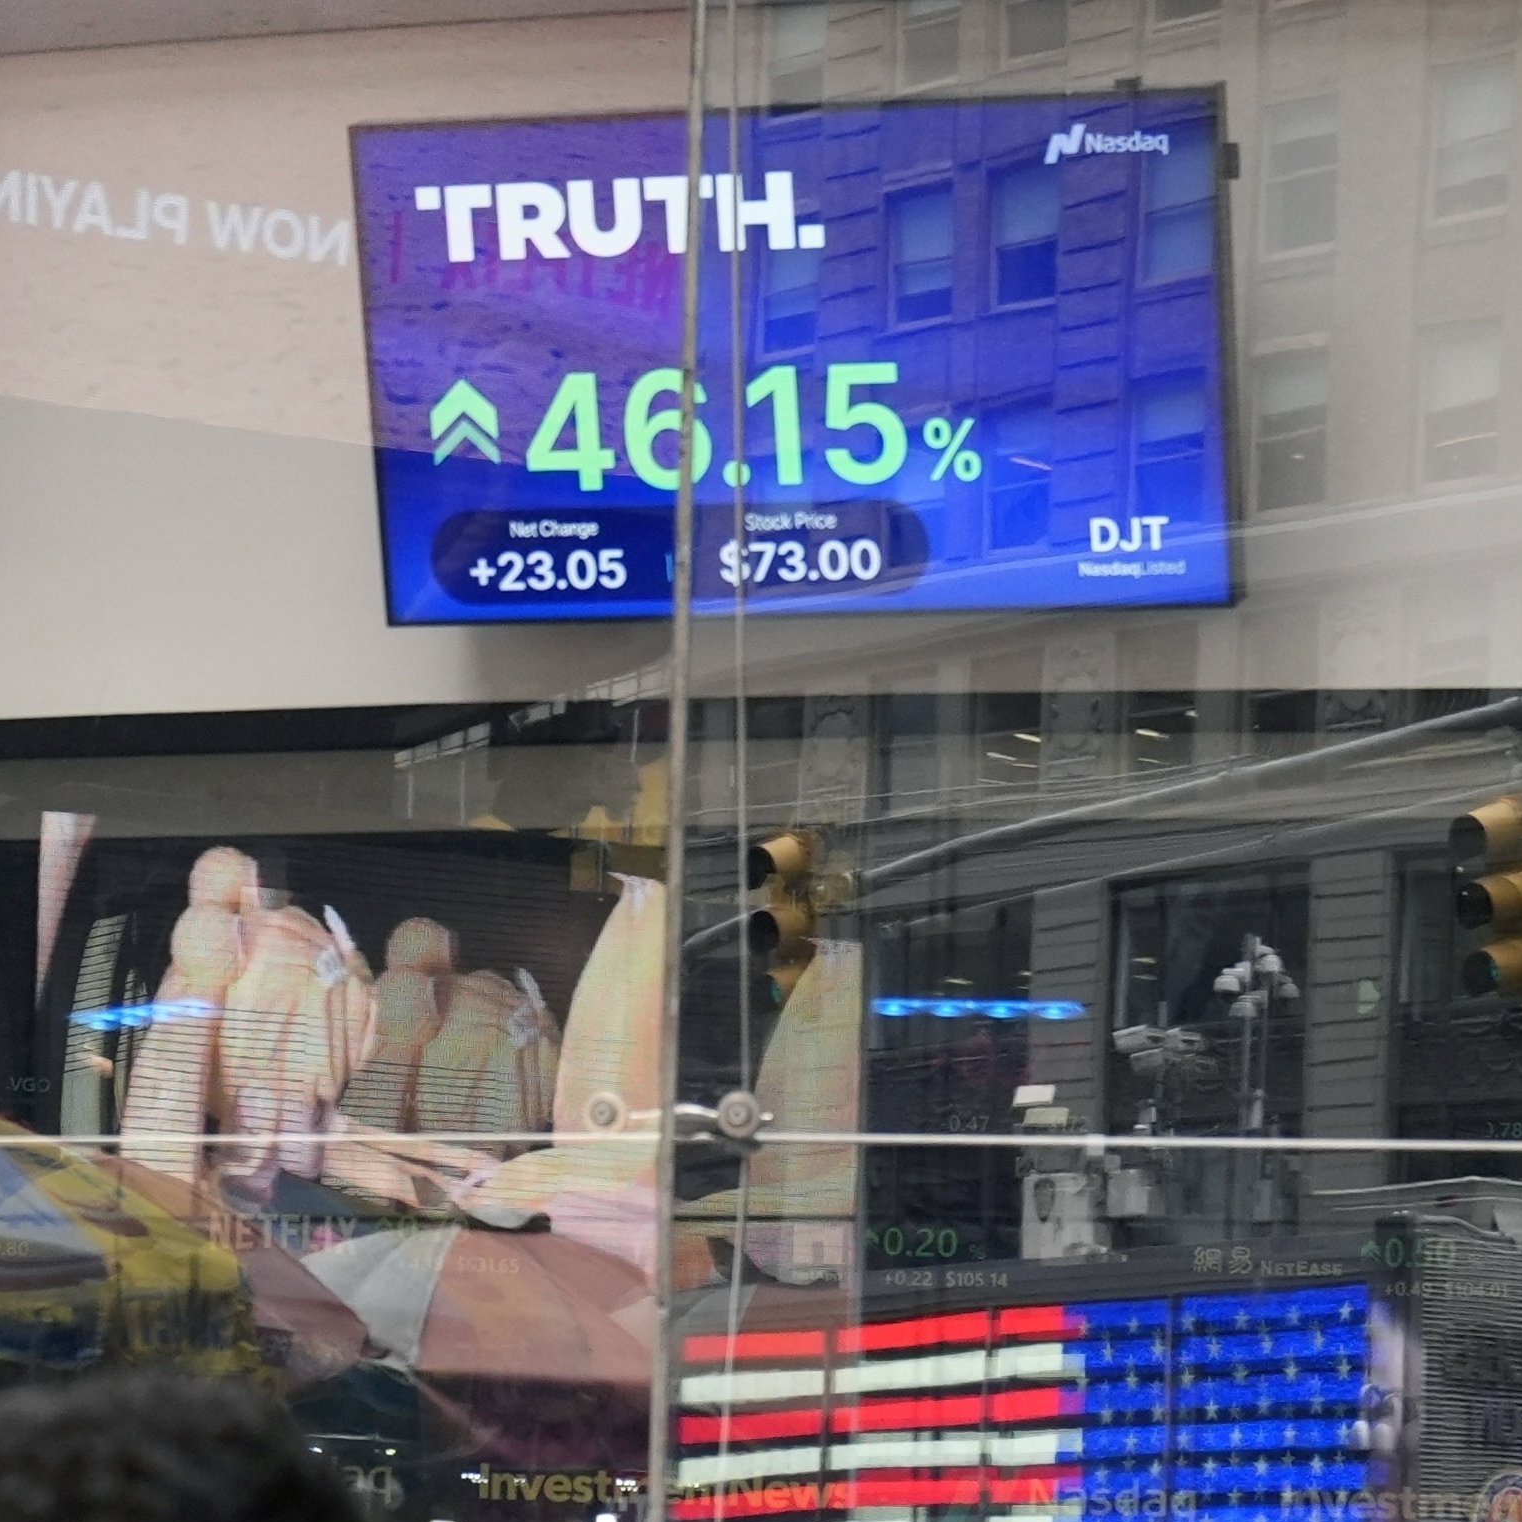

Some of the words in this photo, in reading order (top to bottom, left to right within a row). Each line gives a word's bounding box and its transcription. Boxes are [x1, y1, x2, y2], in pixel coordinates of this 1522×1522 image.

[1083, 128, 1170, 157] Nasdaq
[414, 169, 825, 263] TRUTH.
[509, 518, 538, 538] Net
[541, 518, 600, 541] Change
[744, 511, 789, 532] Stock
[792, 509, 839, 530] Price
[1088, 516, 1170, 554] DJT
[468, 548, 628, 593] +23.05
[719, 537, 881, 588] $73.00
[6, 1076, 51, 1093] VGO
